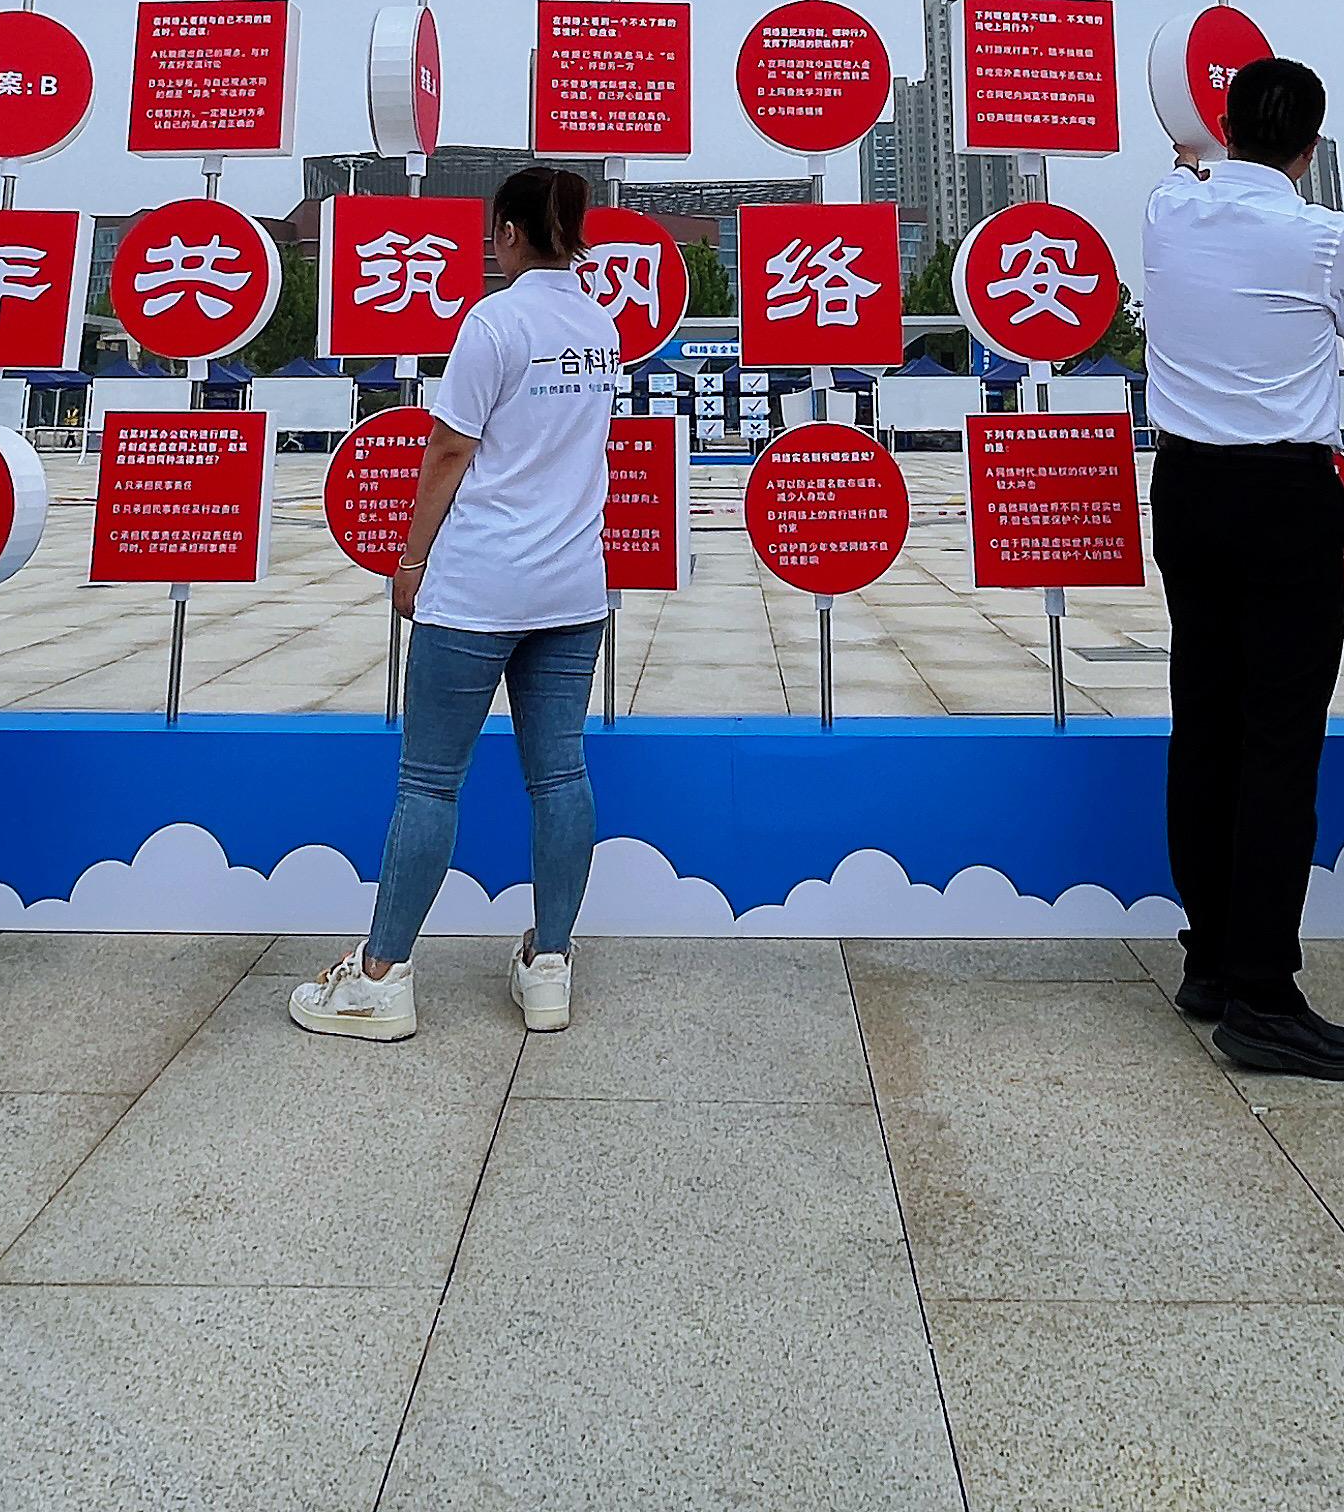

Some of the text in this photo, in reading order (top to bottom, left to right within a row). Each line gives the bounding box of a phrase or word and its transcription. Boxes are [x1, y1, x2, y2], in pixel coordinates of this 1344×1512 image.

[133, 234, 252, 320] 共
[353, 230, 465, 320] 筑
[578, 242, 661, 329] 网
[764, 235, 881, 327] 络
[986, 230, 1100, 325] 安
[346, 469, 355, 480] A
[355, 435, 430, 447] 以下属于网上低
[344, 530, 353, 542] C
[345, 499, 354, 510] B
